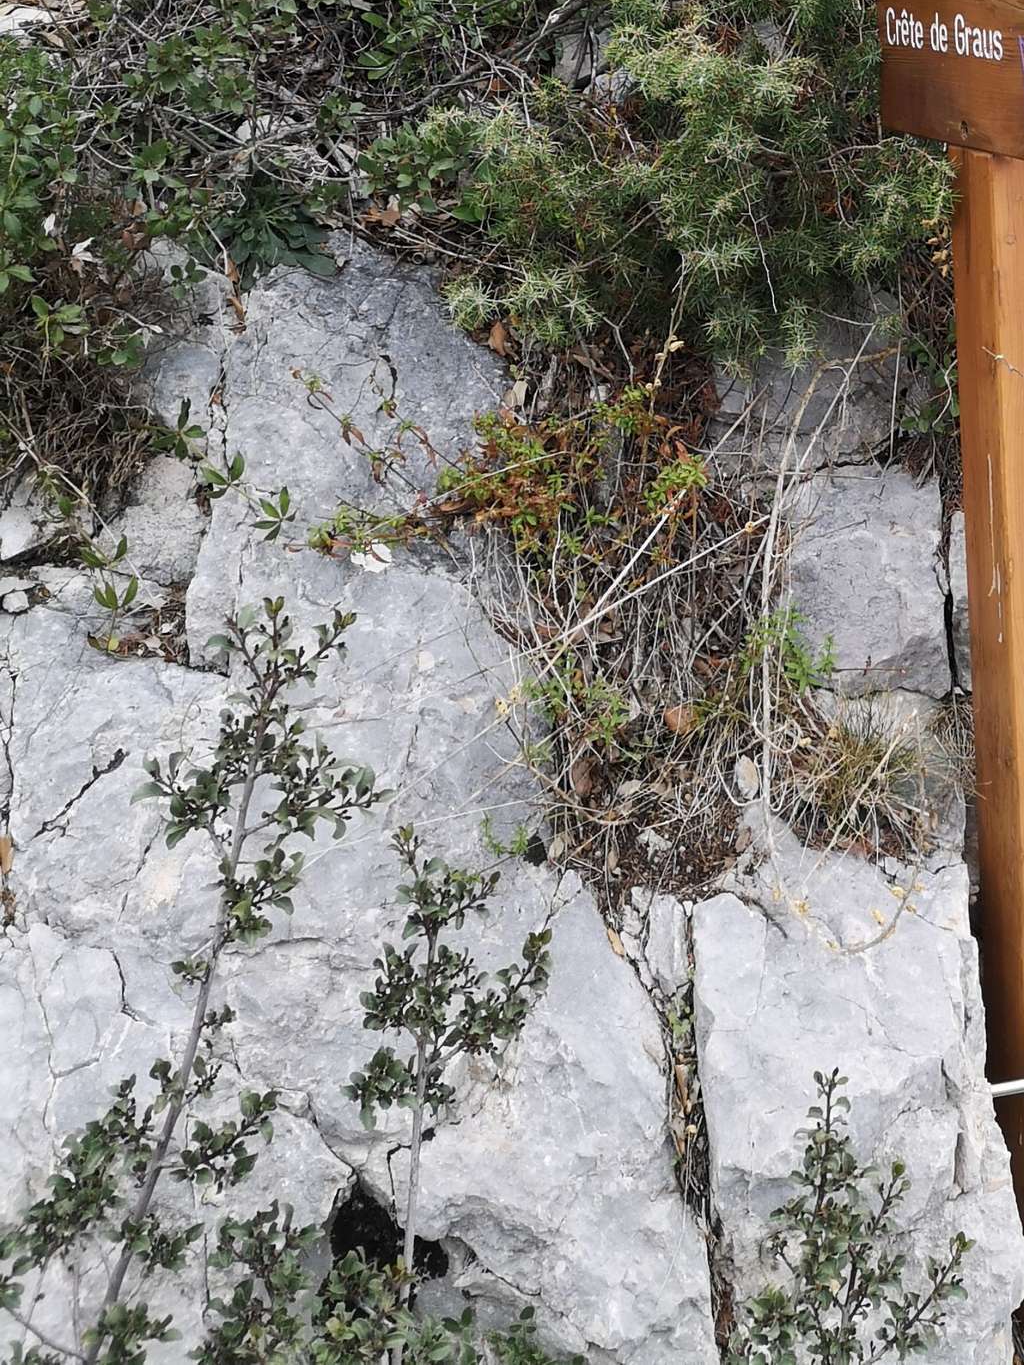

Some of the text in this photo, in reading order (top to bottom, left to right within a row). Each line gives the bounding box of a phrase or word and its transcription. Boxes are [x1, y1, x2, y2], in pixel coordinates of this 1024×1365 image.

[885, 6, 1004, 61] Crête de Graus
